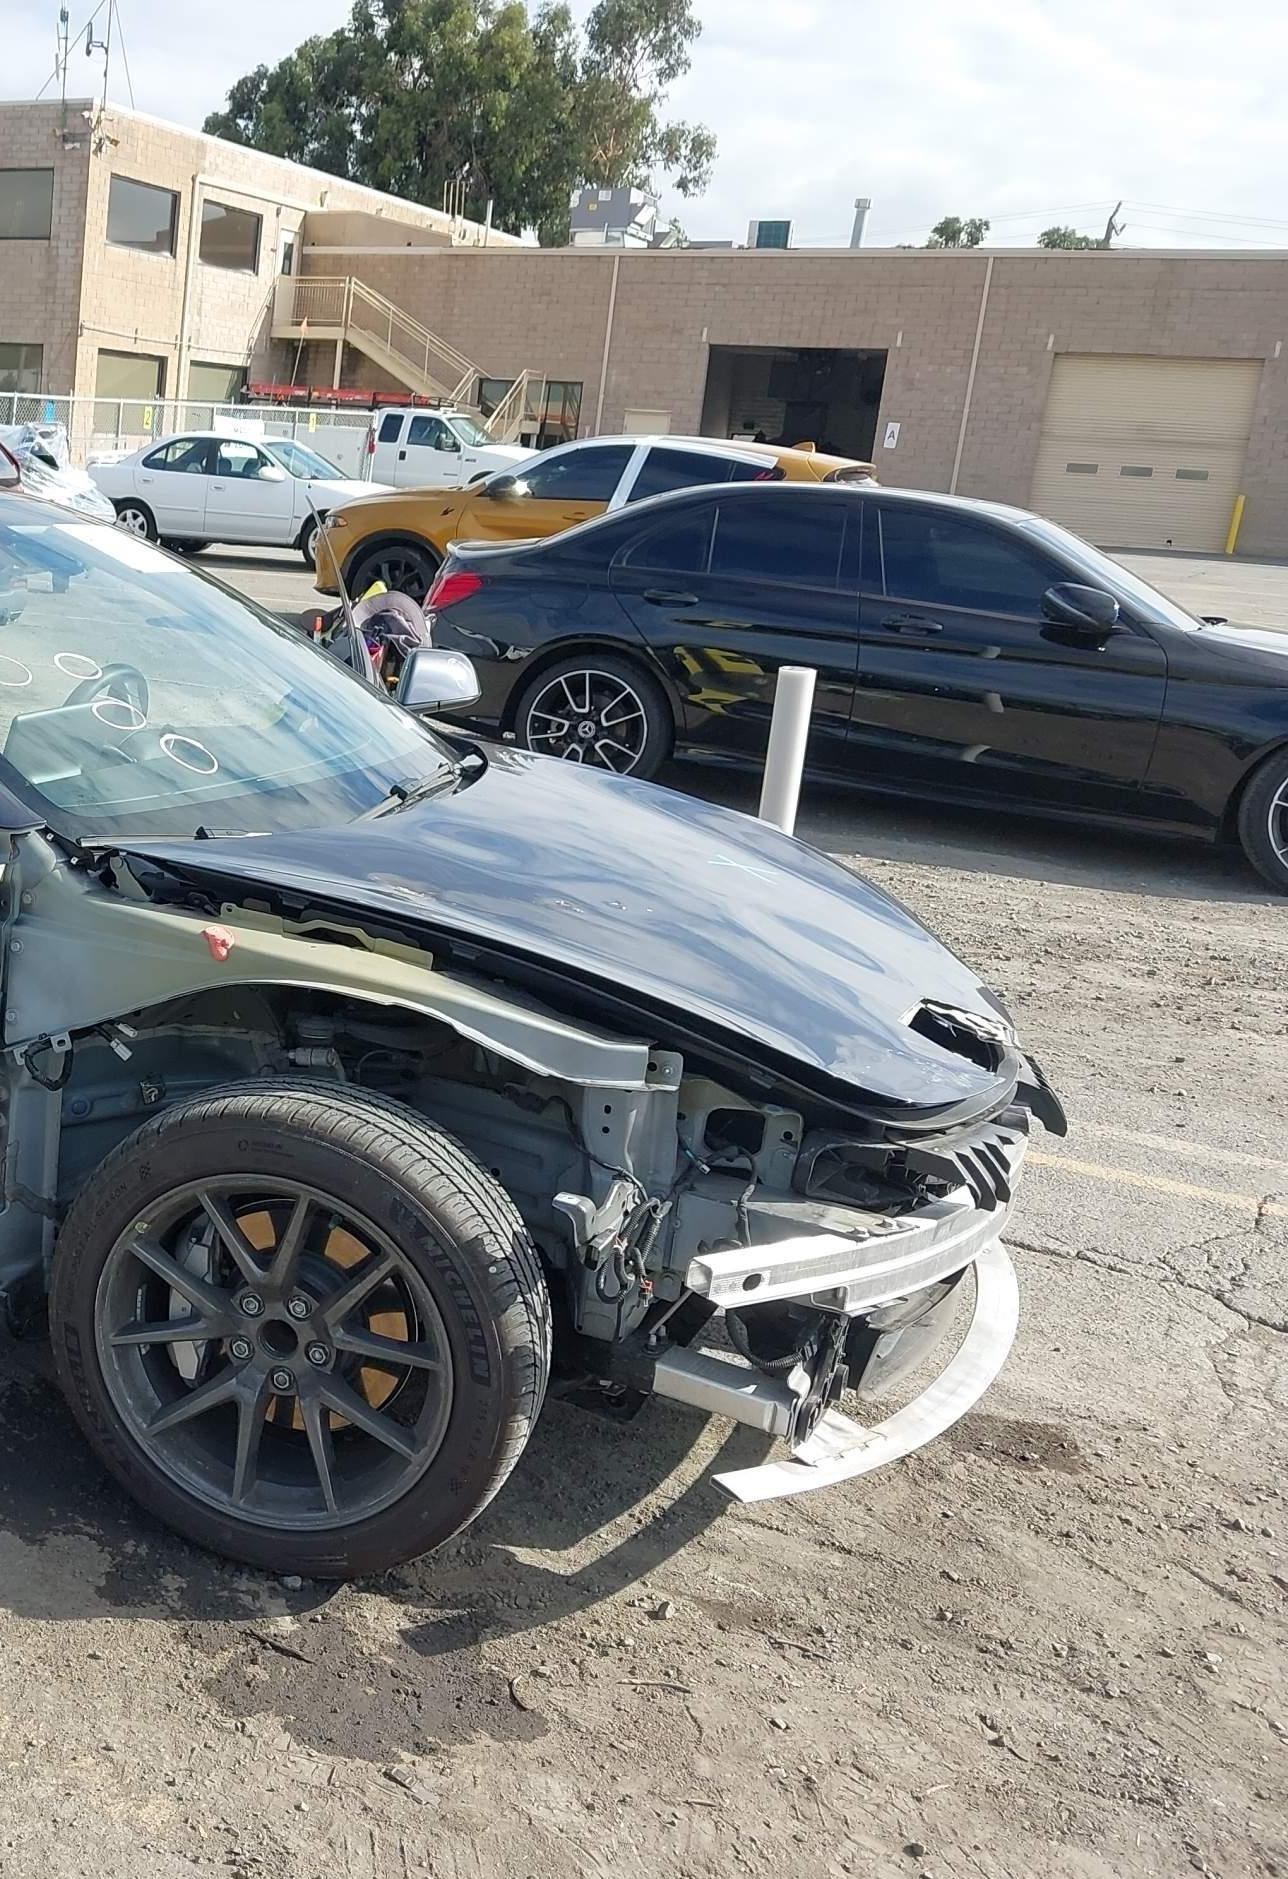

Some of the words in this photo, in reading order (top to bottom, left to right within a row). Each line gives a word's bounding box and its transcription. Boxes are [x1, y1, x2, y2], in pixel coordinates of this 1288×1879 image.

[145, 409, 152, 426] 2
[887, 429, 896, 441] A
[418, 1232, 491, 1380] MICHELIN
